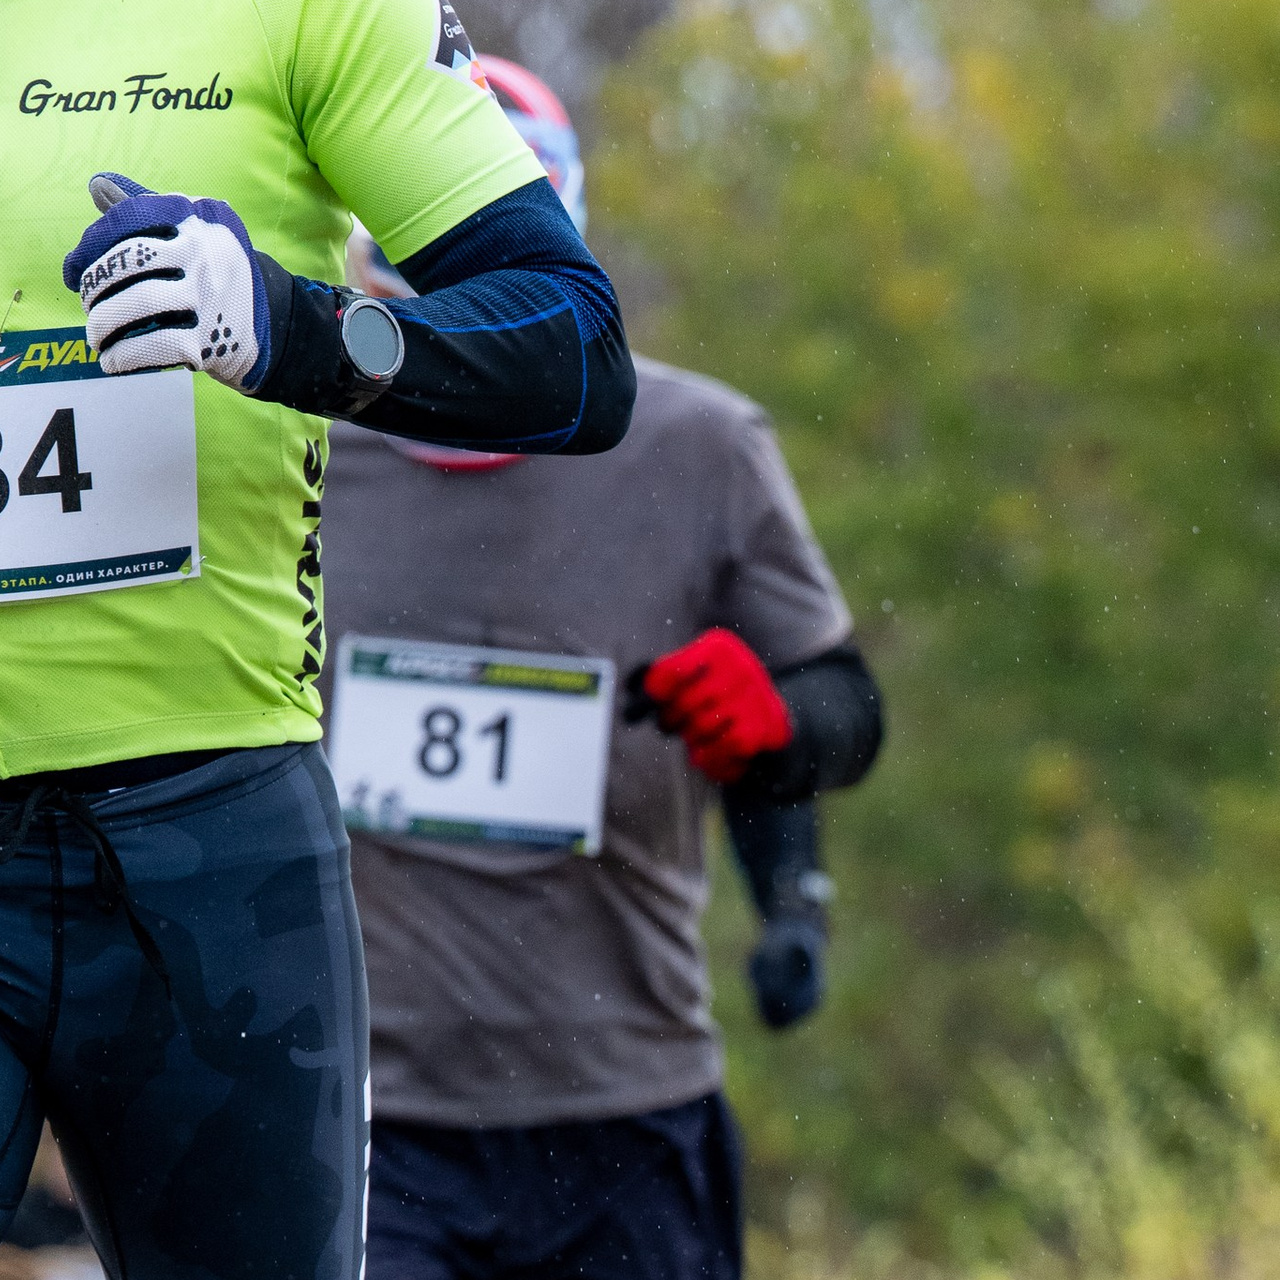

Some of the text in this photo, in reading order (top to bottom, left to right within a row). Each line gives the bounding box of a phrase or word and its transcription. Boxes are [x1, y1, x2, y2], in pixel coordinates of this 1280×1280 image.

[19, 72, 233, 117] Gran Fondo
[1, 576, 52, 589] ЭТАПА.
[55, 570, 94, 583] ОДИН
[97, 560, 169, 579] ХАРАКТЕР.
[419, 706, 512, 786] 81
